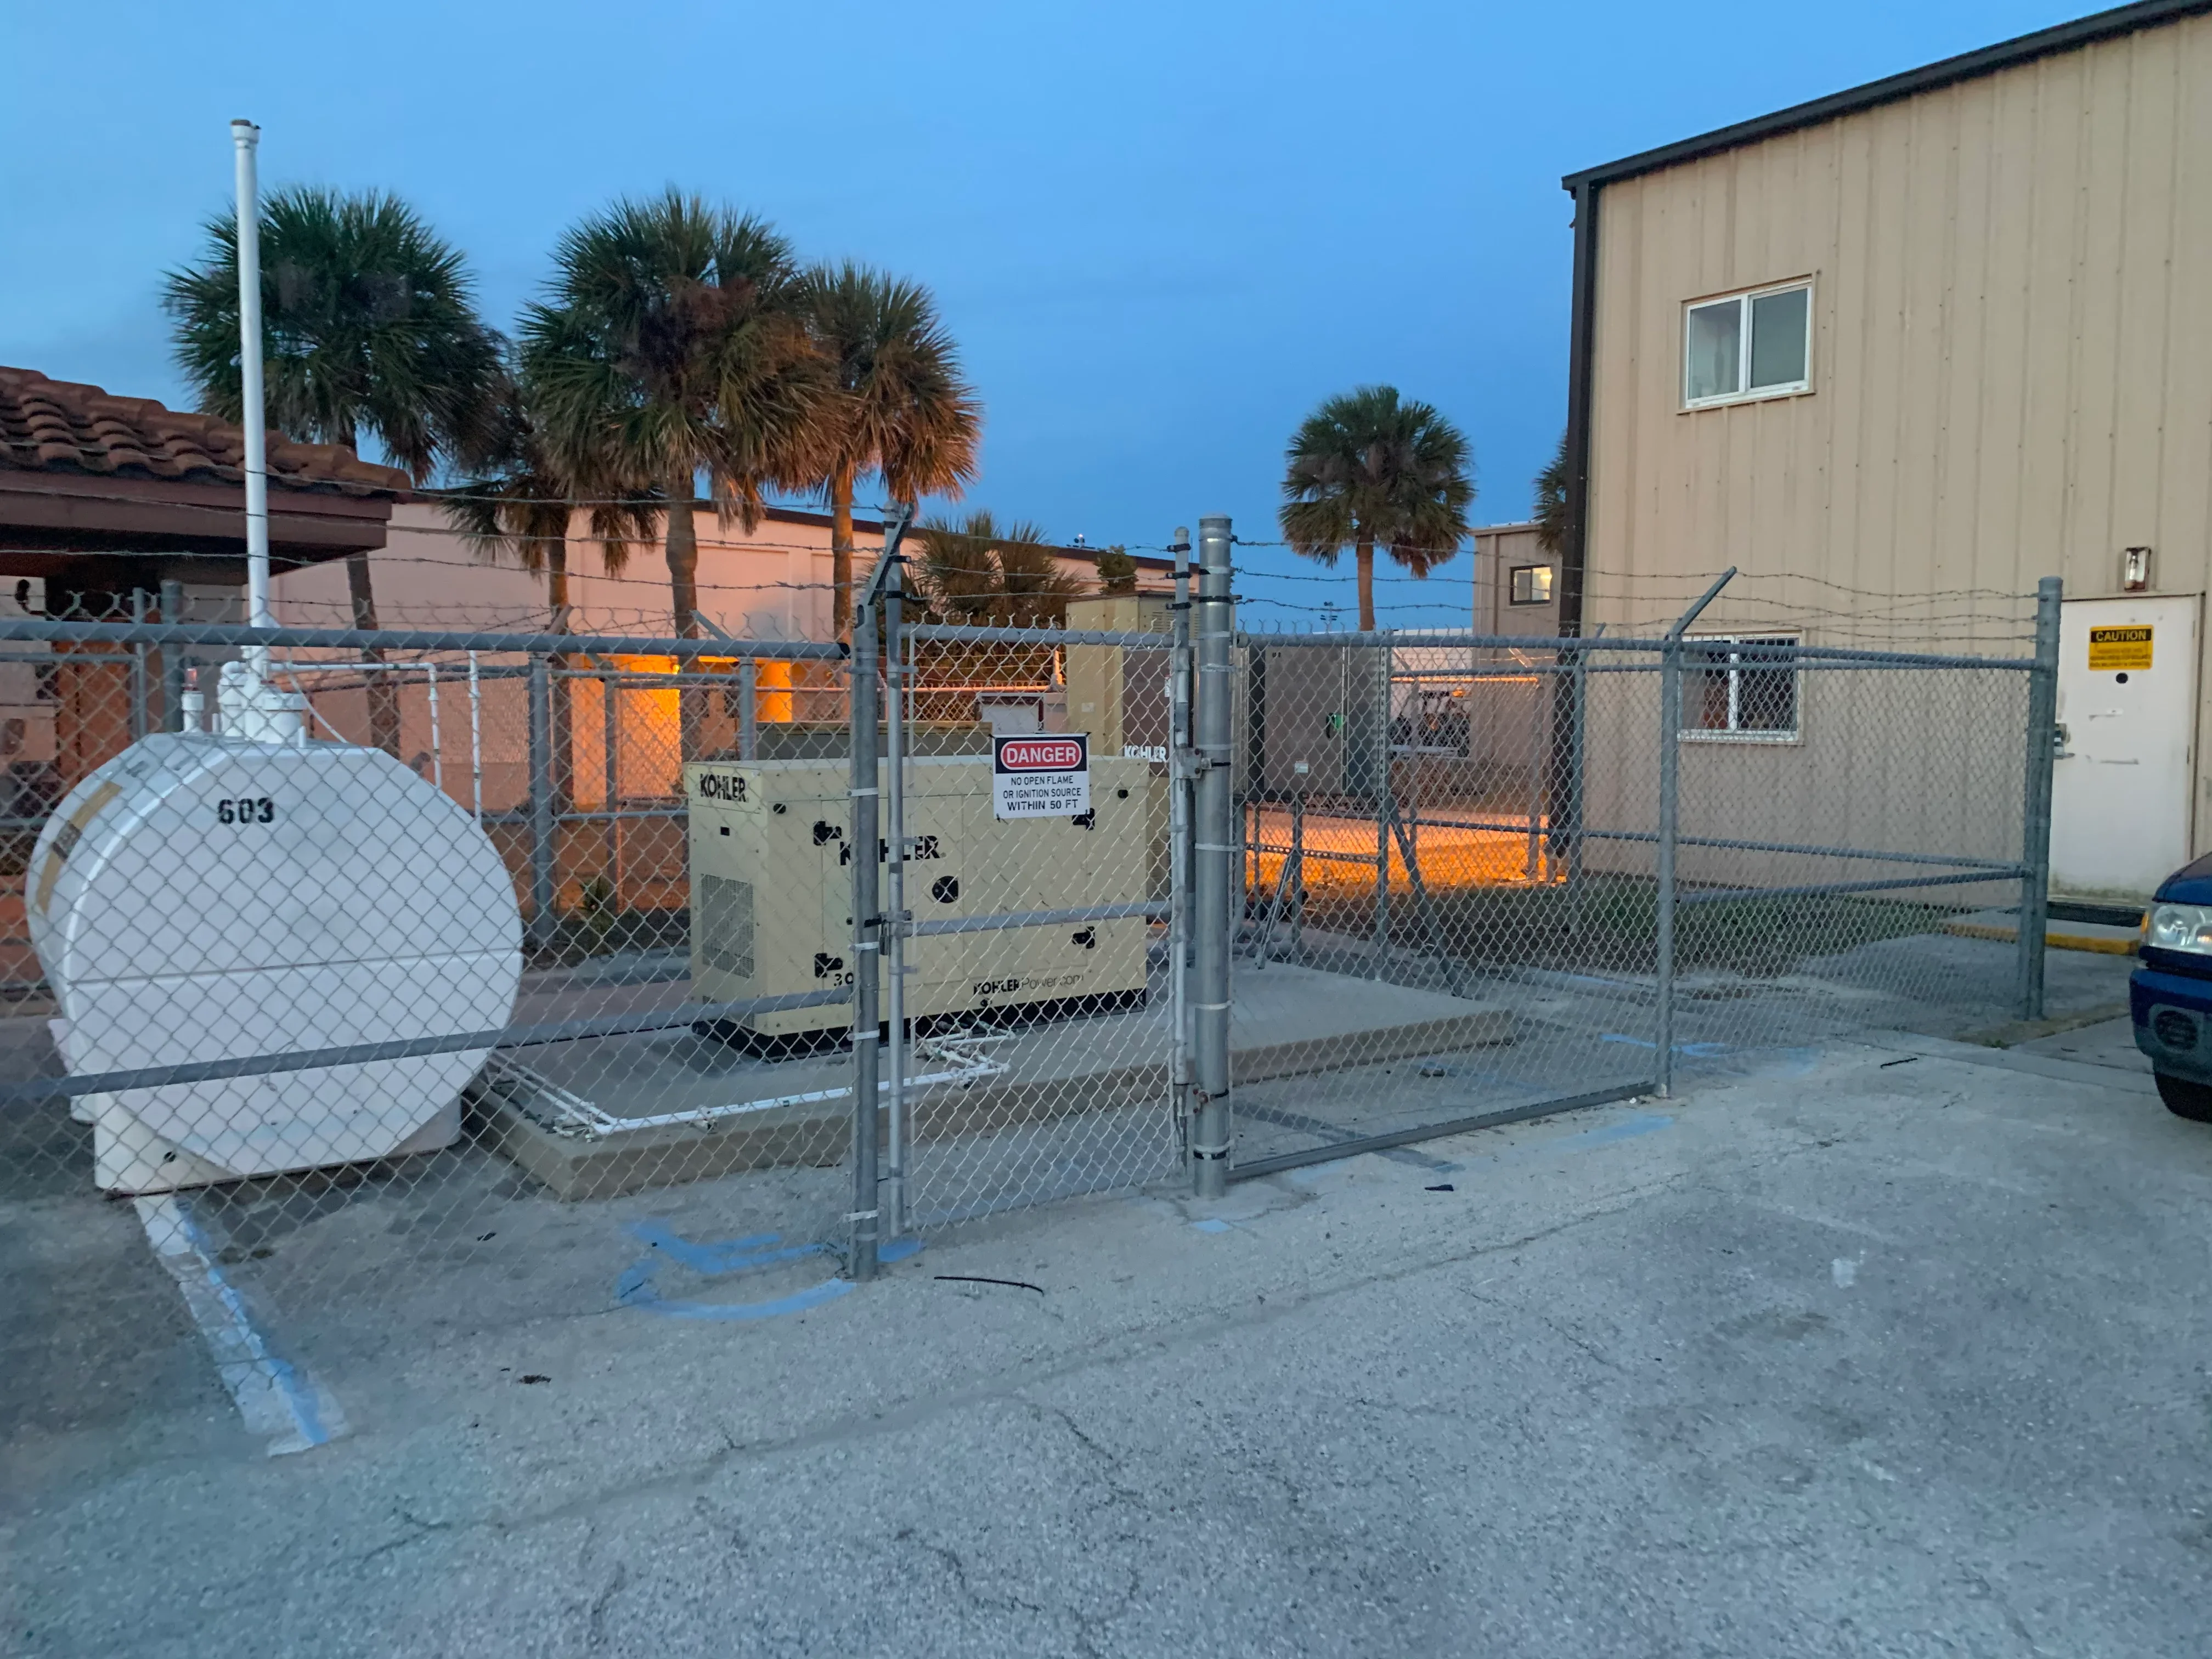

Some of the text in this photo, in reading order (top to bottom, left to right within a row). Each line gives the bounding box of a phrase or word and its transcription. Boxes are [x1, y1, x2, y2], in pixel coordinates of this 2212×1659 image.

[2096, 630, 2147, 641] CAUTION
[1006, 747, 1077, 763] DANGER
[1124, 745, 1167, 763] KOHLER
[700, 774, 747, 803] KOHLER
[1011, 775, 1074, 786] NO OPEN FLAME
[1003, 787, 1081, 799] OR IGNITION SOURCE
[218, 798, 273, 824] 603
[1007, 799, 1078, 811] WITHIN 50 FT
[840, 836, 940, 865] KHER
